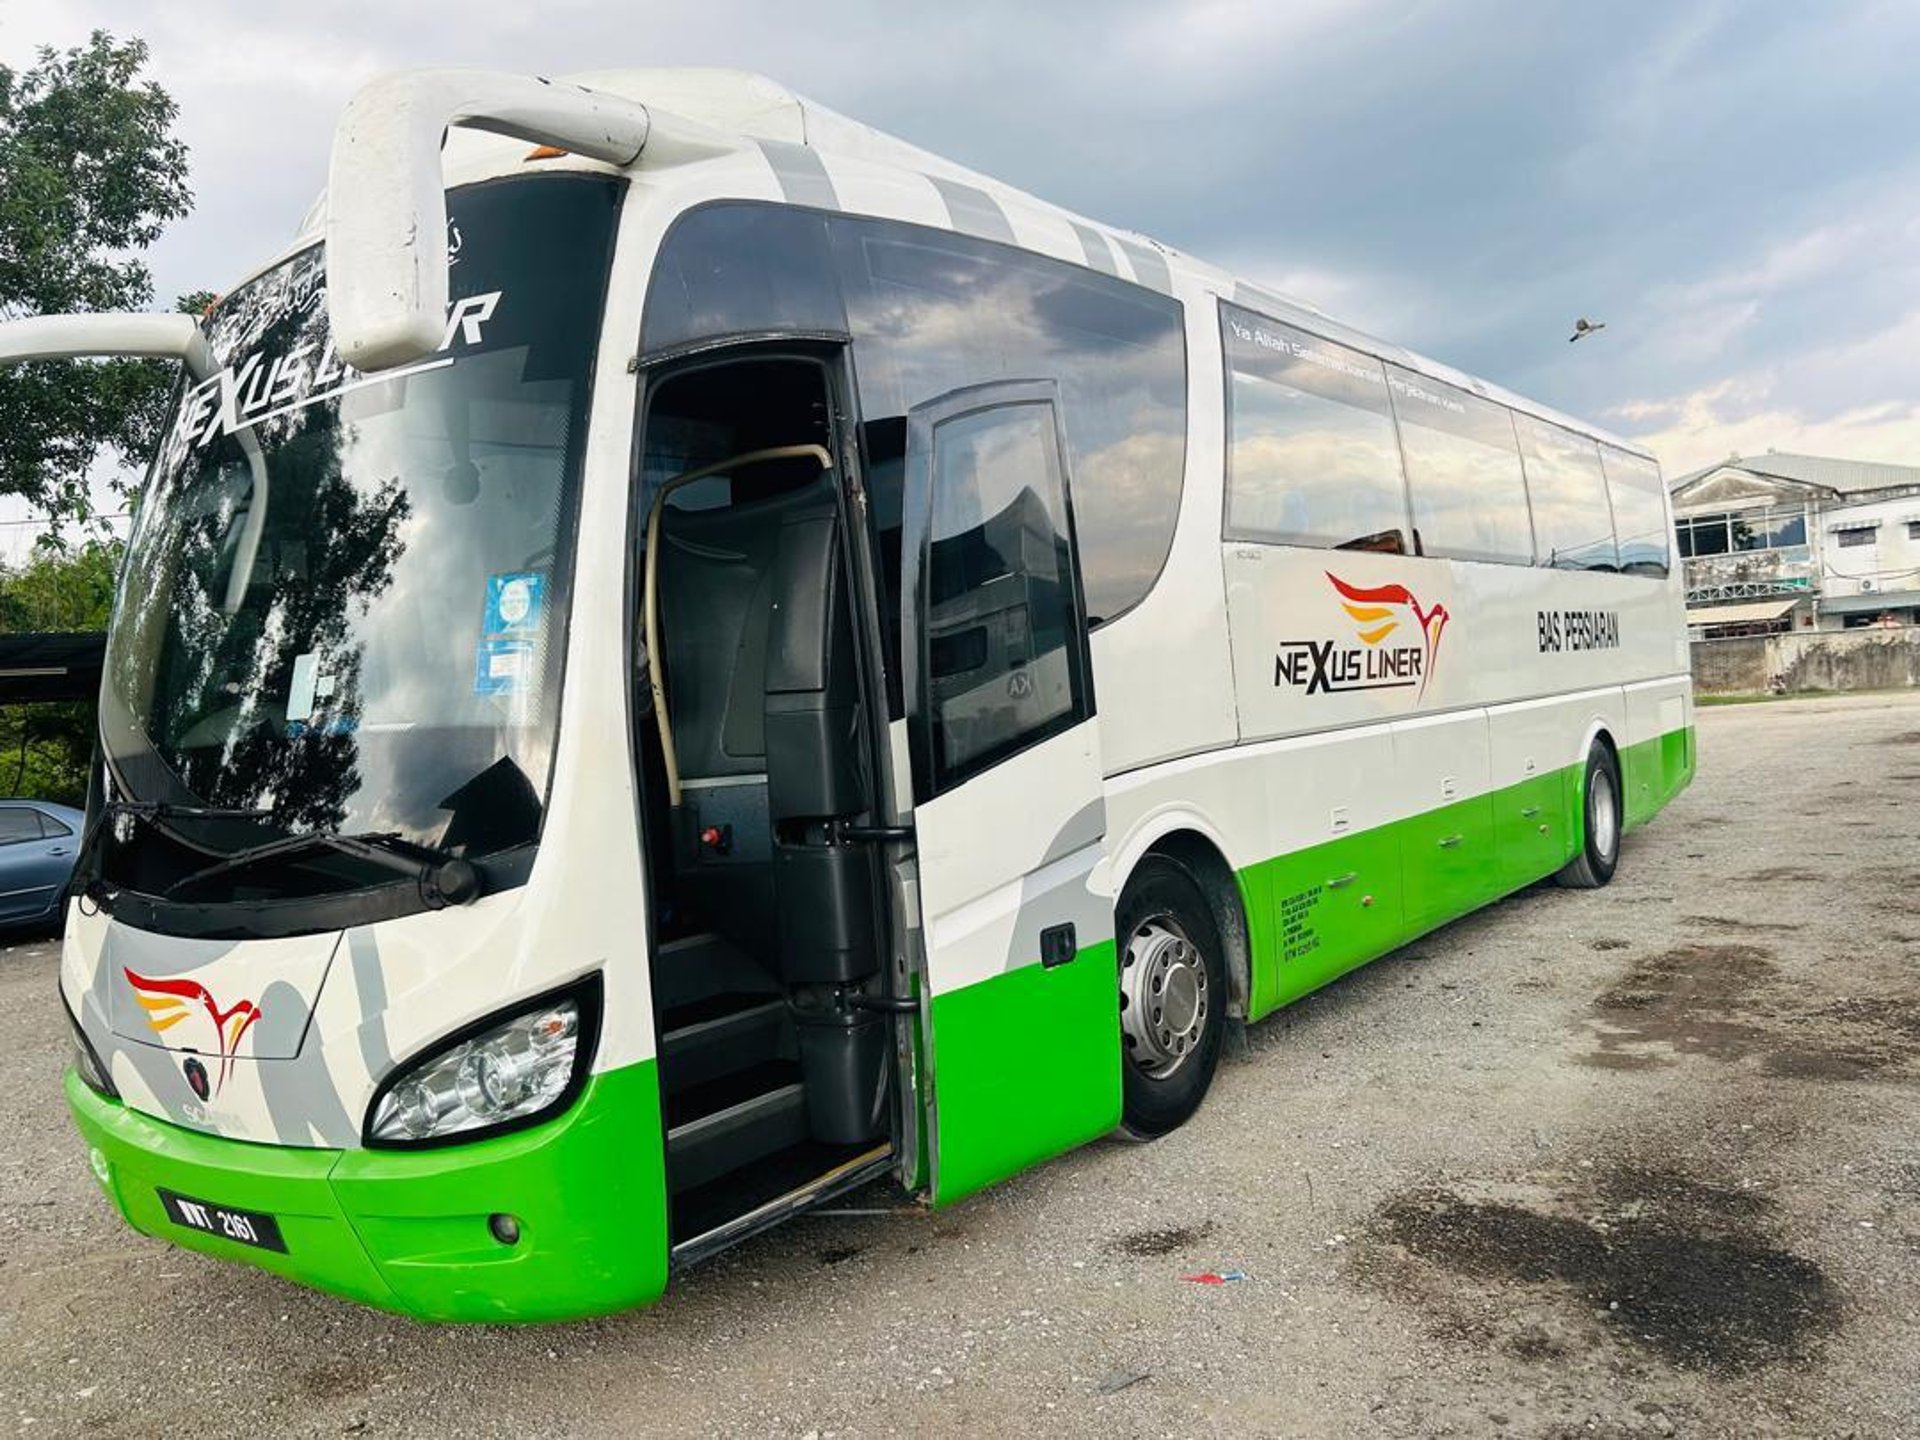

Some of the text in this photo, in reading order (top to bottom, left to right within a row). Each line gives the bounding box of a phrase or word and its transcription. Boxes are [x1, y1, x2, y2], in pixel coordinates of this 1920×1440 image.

[1230, 321, 1251, 340] Ya
[1254, 329, 1290, 355] Allah
[165, 342, 320, 450] NEXUS
[1537, 611, 1619, 652] BAS PERSIARAN
[1274, 640, 1422, 696] NEXUS LINER
[217, 1211, 258, 1242] 2161
